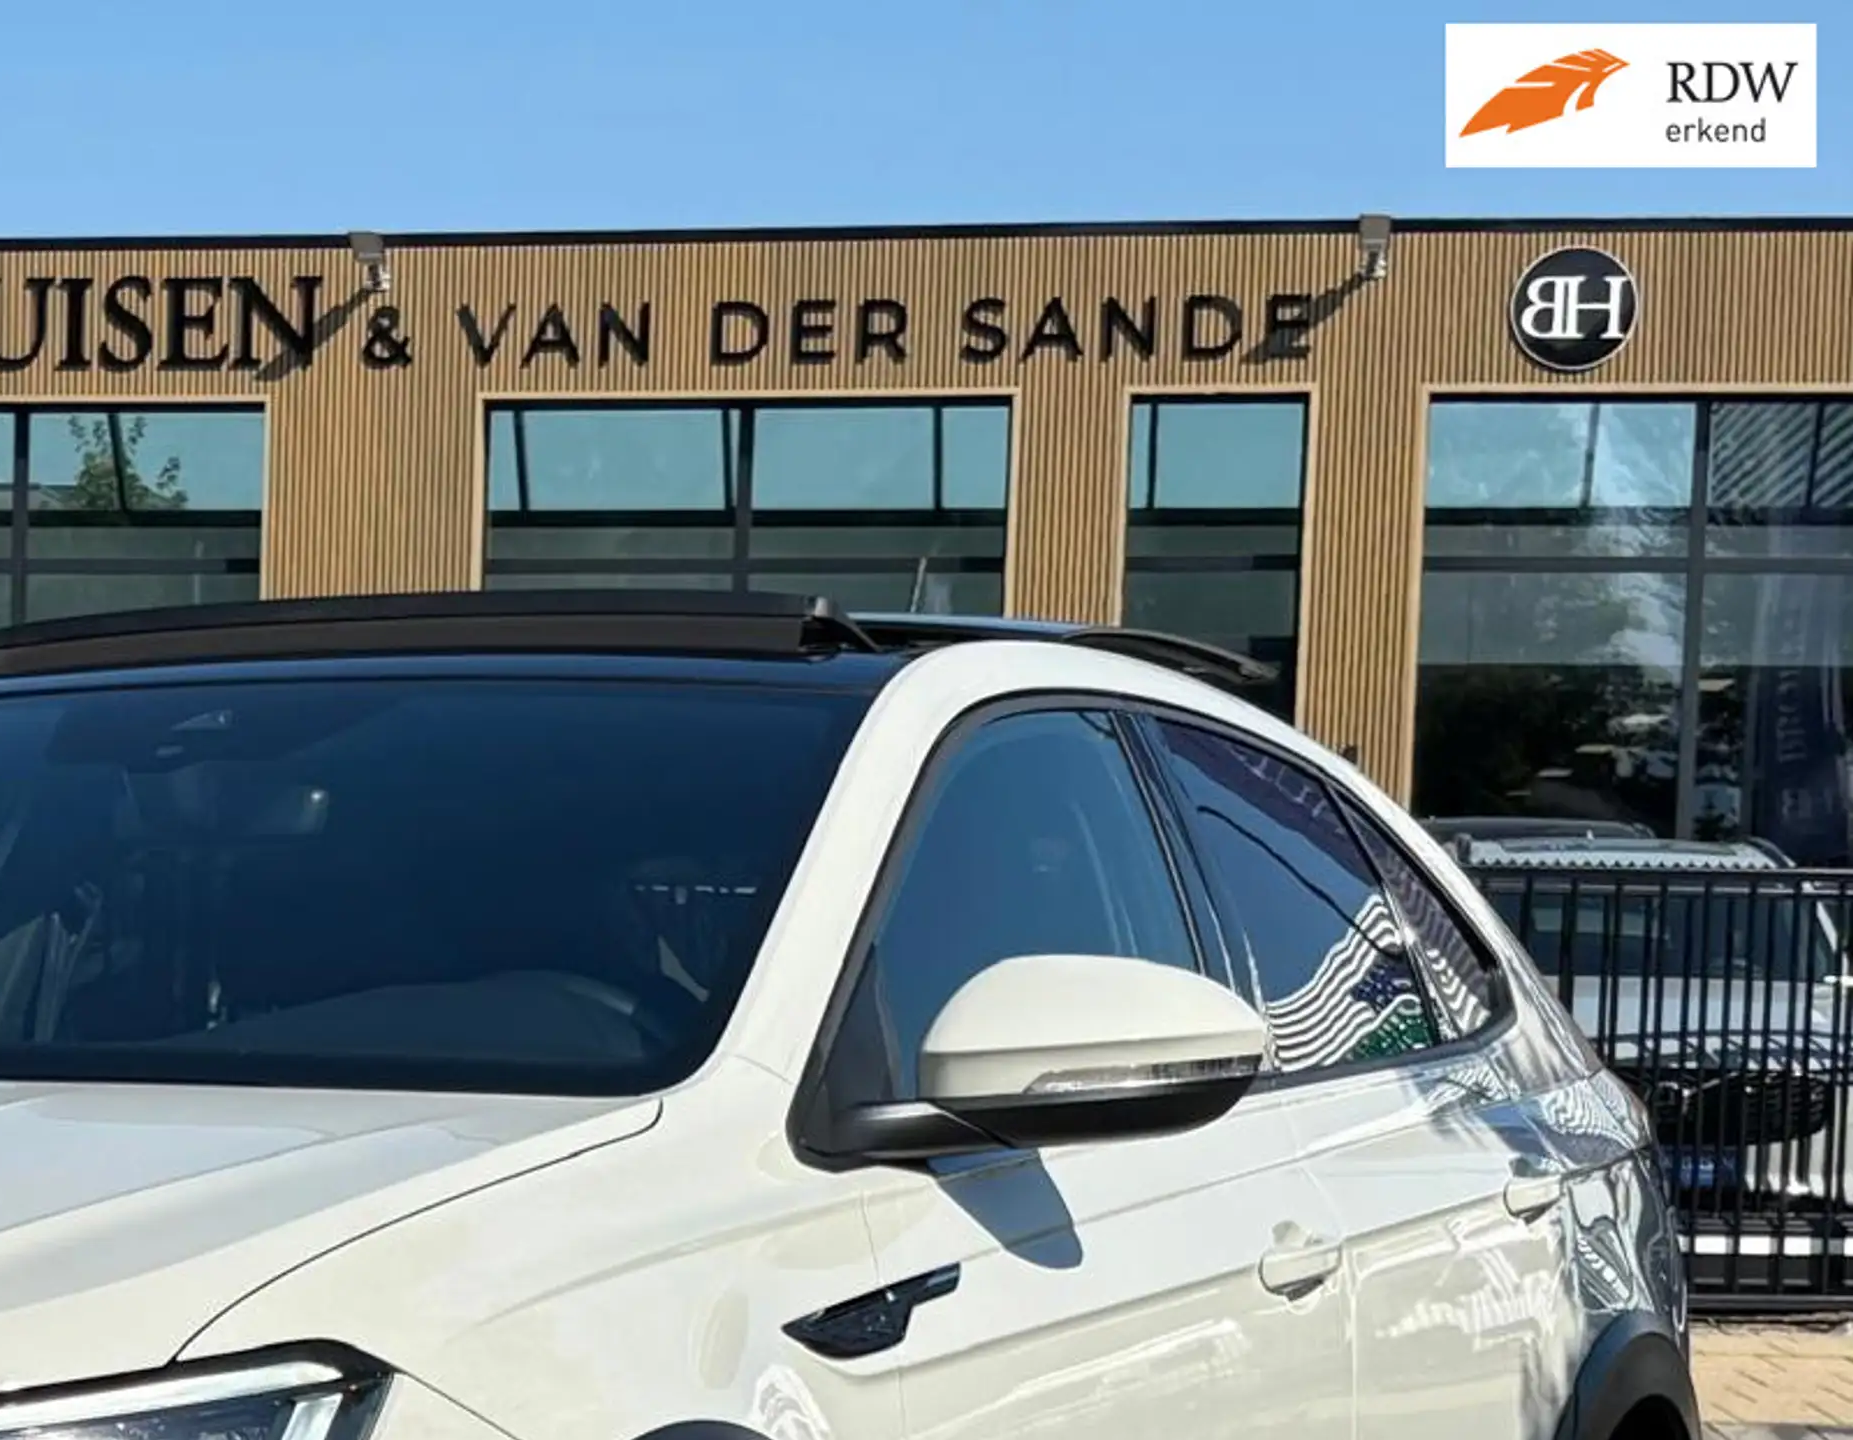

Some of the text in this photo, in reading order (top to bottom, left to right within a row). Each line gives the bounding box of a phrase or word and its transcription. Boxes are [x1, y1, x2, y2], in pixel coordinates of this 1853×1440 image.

[361, 303, 414, 369] &
[455, 300, 652, 369] VAN
[708, 298, 909, 366] DER
[957, 293, 1314, 366] SANDE
